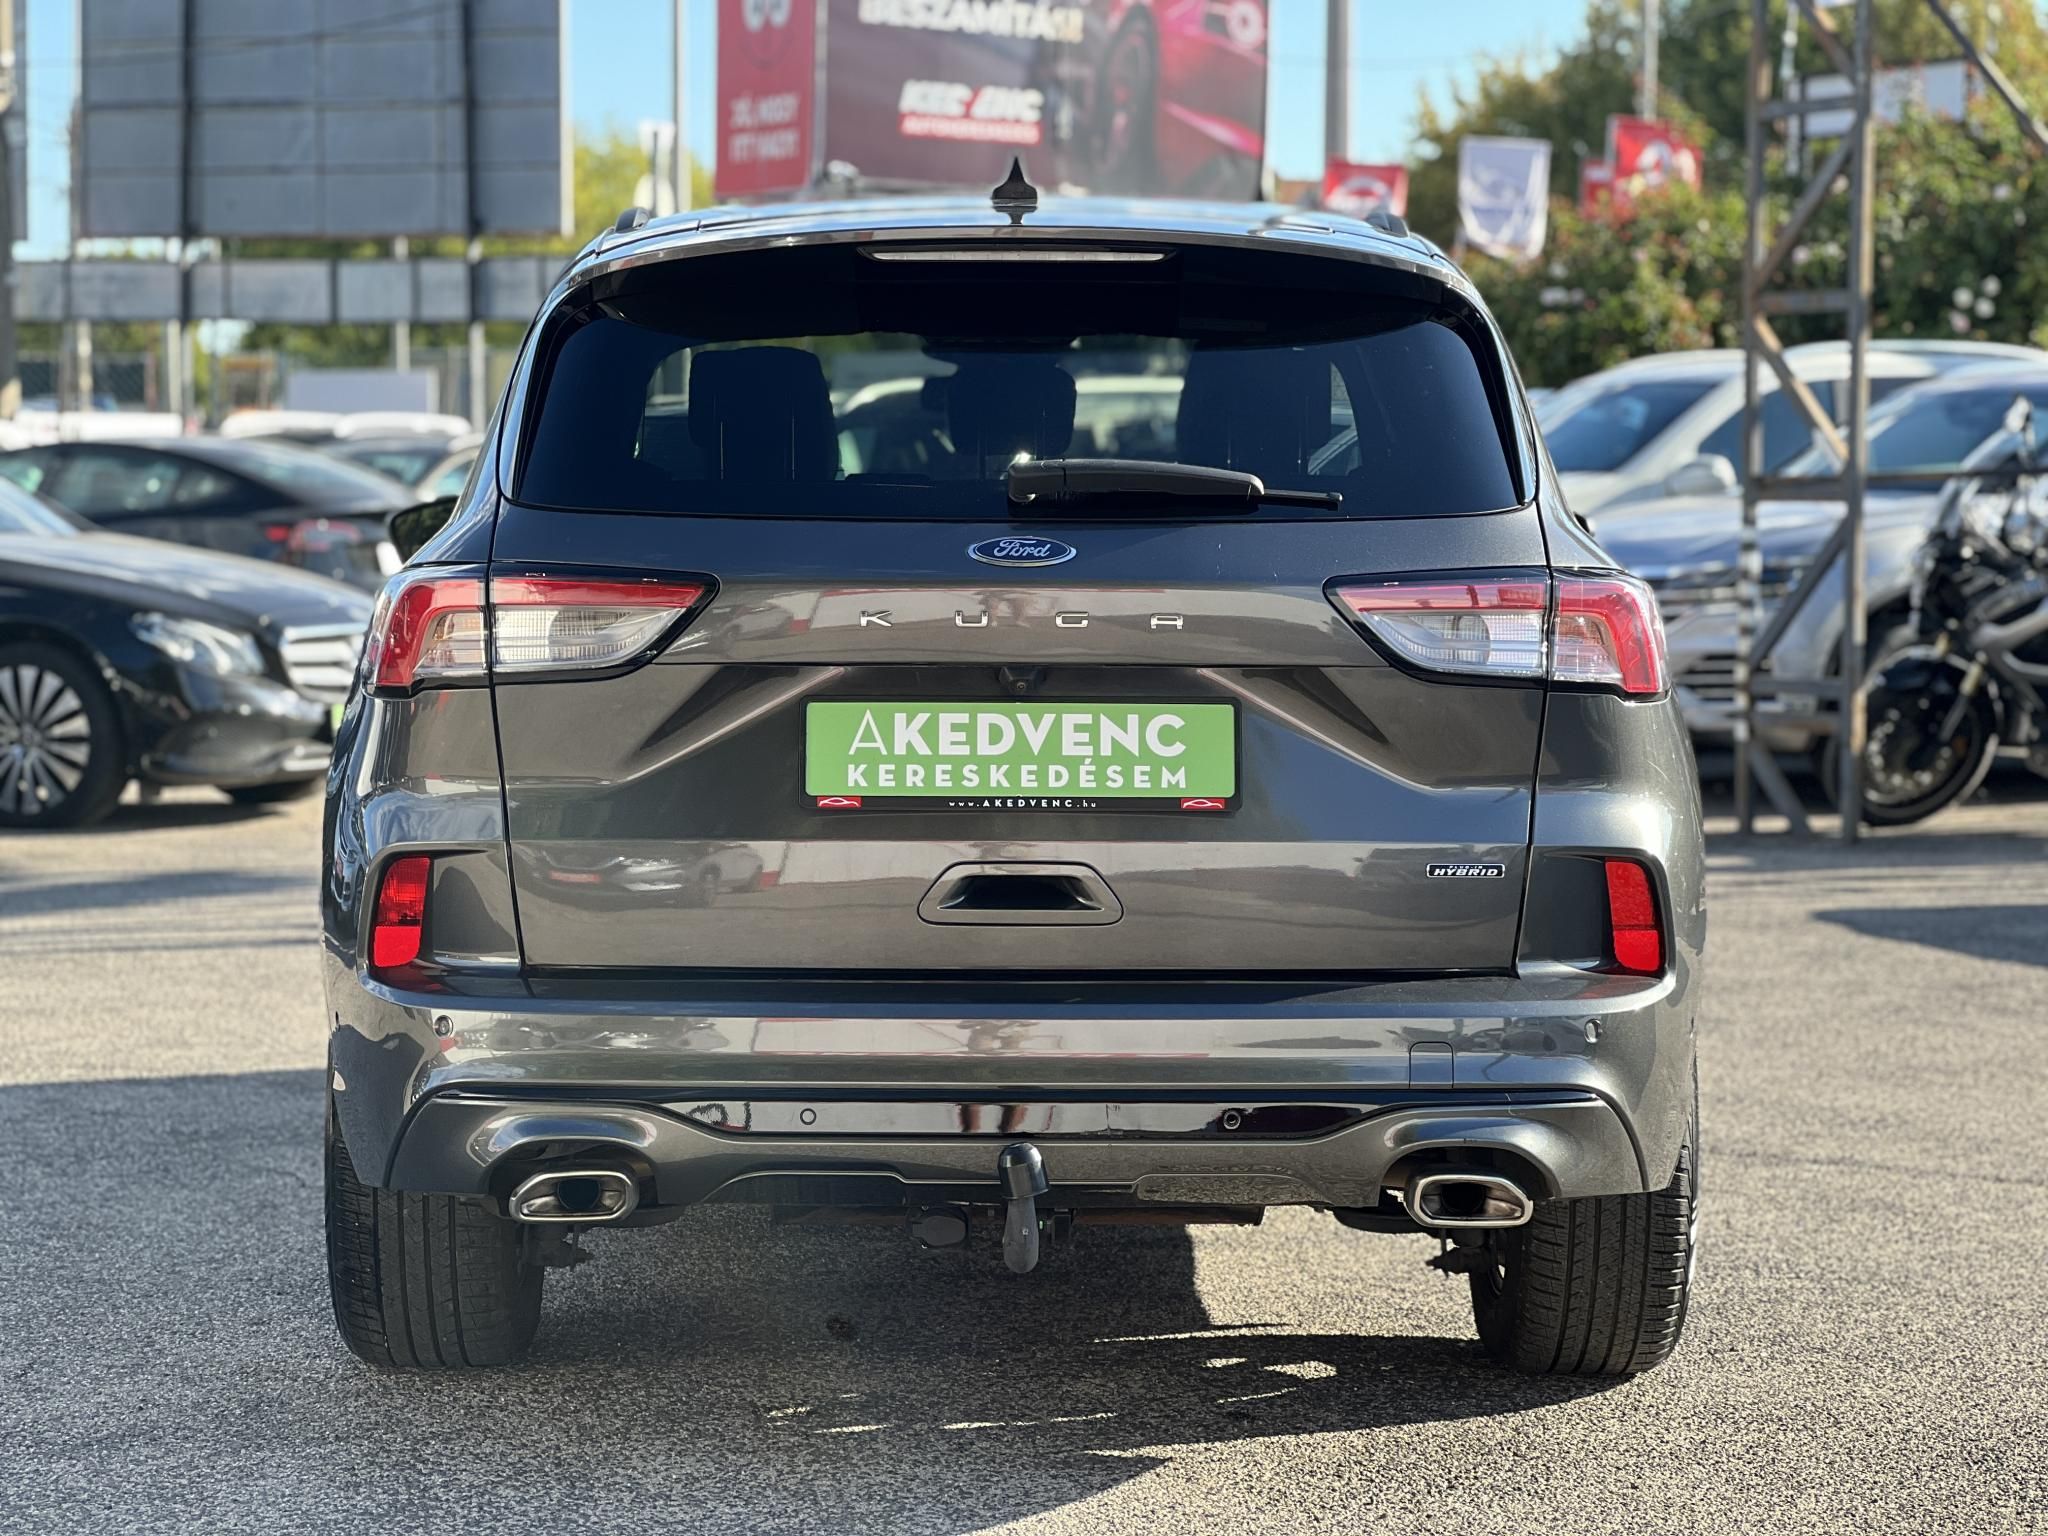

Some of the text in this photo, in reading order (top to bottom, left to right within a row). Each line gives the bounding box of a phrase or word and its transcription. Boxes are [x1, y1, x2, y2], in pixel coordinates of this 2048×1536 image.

[994, 540, 1051, 557] Ford
[860, 610, 1184, 630] KUGA
[847, 758, 1187, 789] KERESKEDÉSEM
[949, 799, 1096, 808] www.AKEDVENC.hu
[1434, 868, 1498, 876] HYBRID
